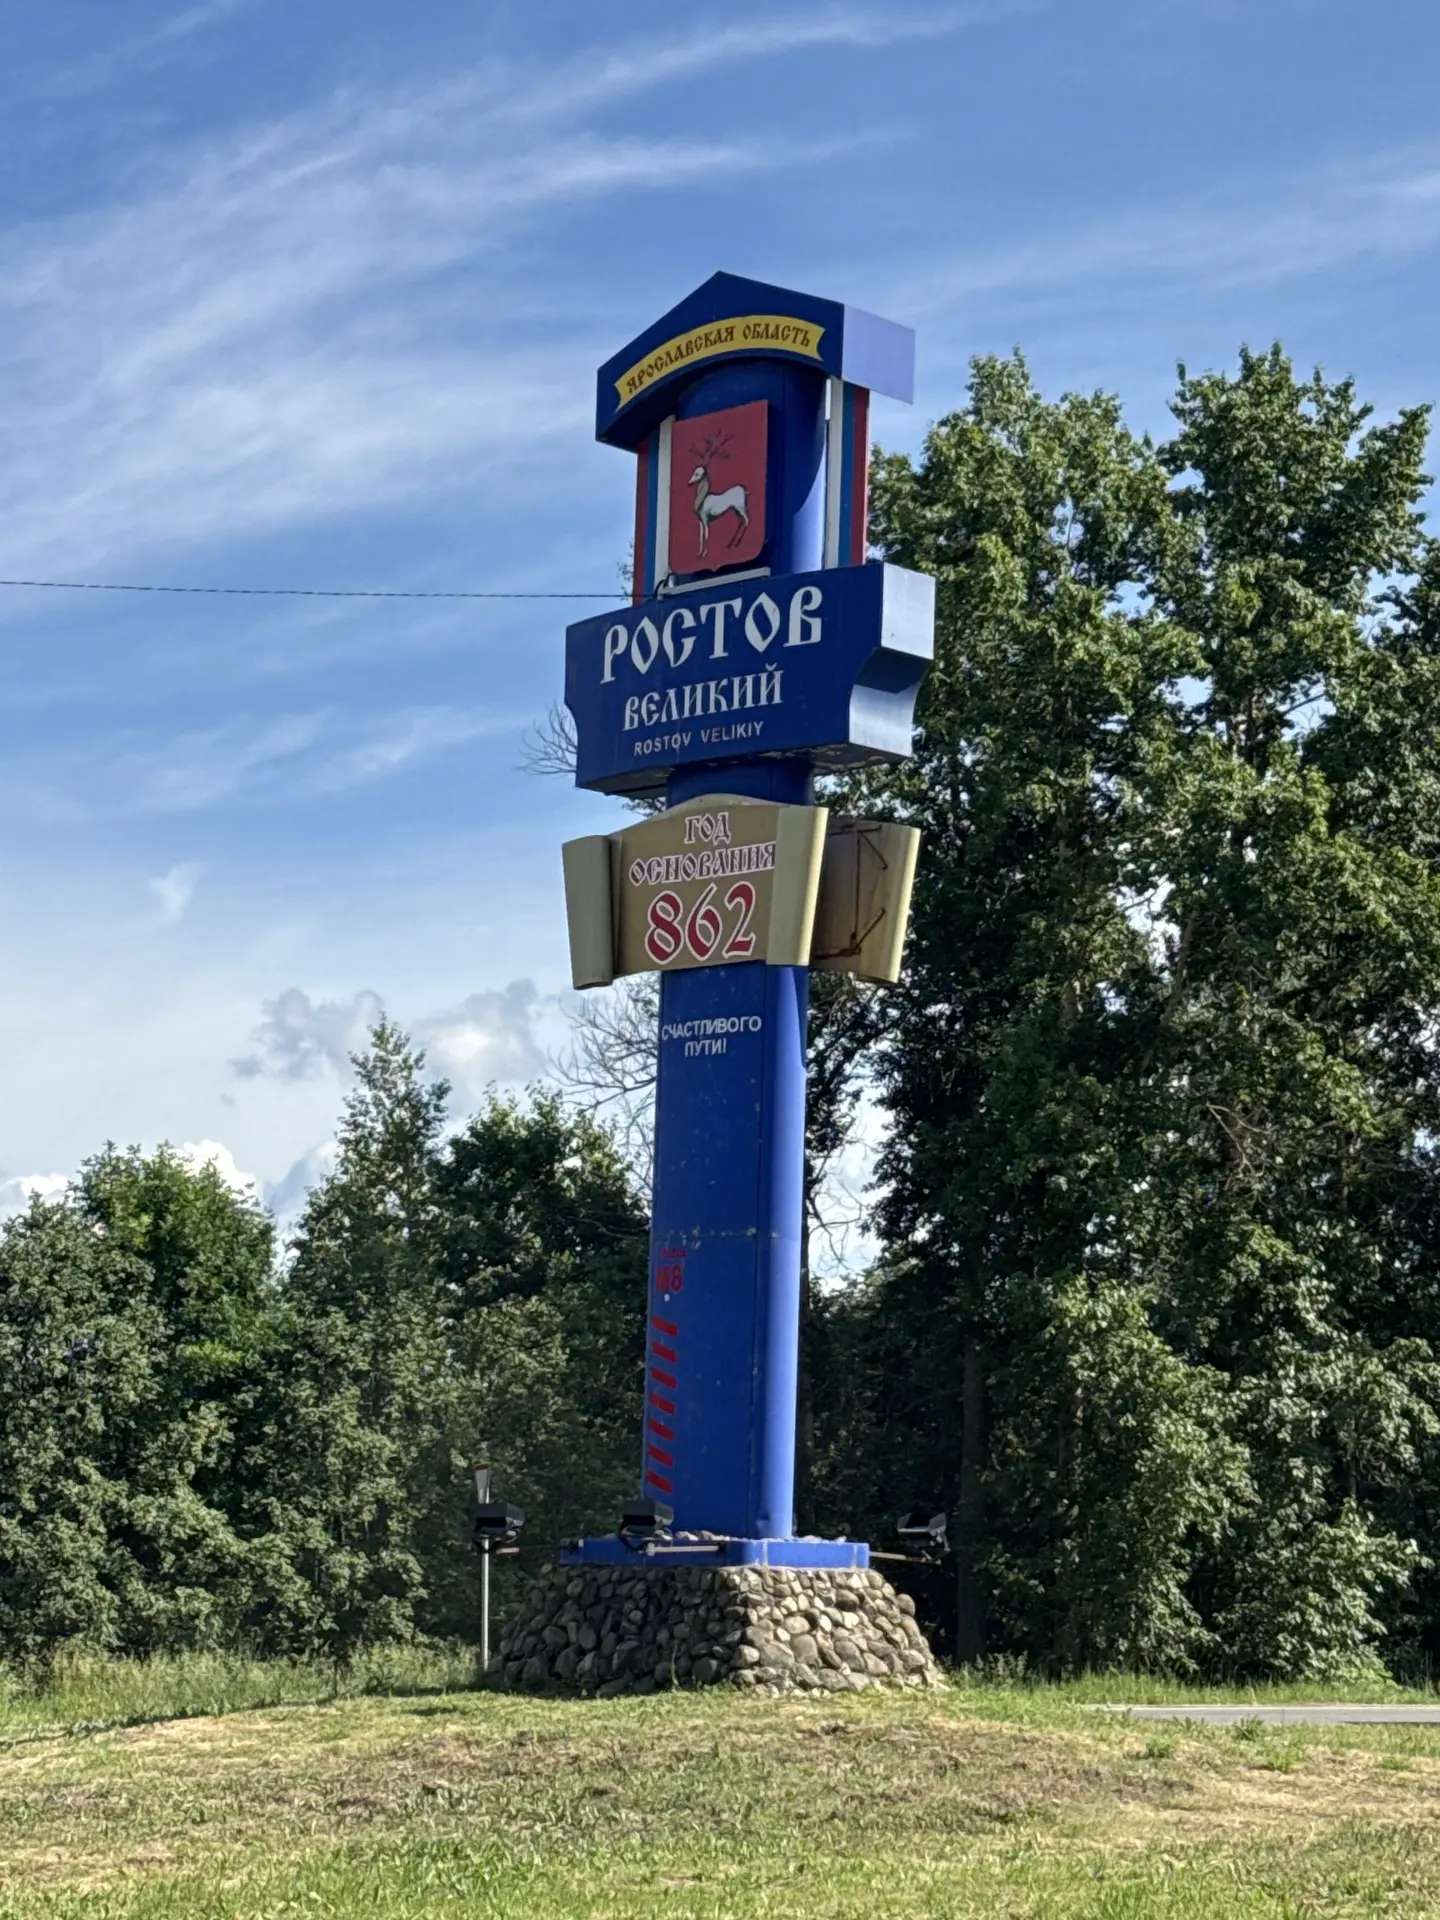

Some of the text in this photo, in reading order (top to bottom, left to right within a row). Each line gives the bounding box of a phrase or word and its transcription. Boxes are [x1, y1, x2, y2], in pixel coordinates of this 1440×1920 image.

[626, 322, 811, 394] ЯРОСЛАВСКАЯ ОБЛАСТЬ
[600, 586, 823, 684] РОСТОВ
[622, 662, 784, 731] ВЕЛИКИЙ
[634, 720, 764, 756] ROSTOV VELIKIY
[684, 811, 731, 846] ГОД
[629, 841, 776, 887] ОСНОВАНИЯ
[645, 880, 756, 965] 862
[661, 1015, 762, 1040] СЧАСТЛИВОГО
[684, 1037, 727, 1058] ПУТИ!
